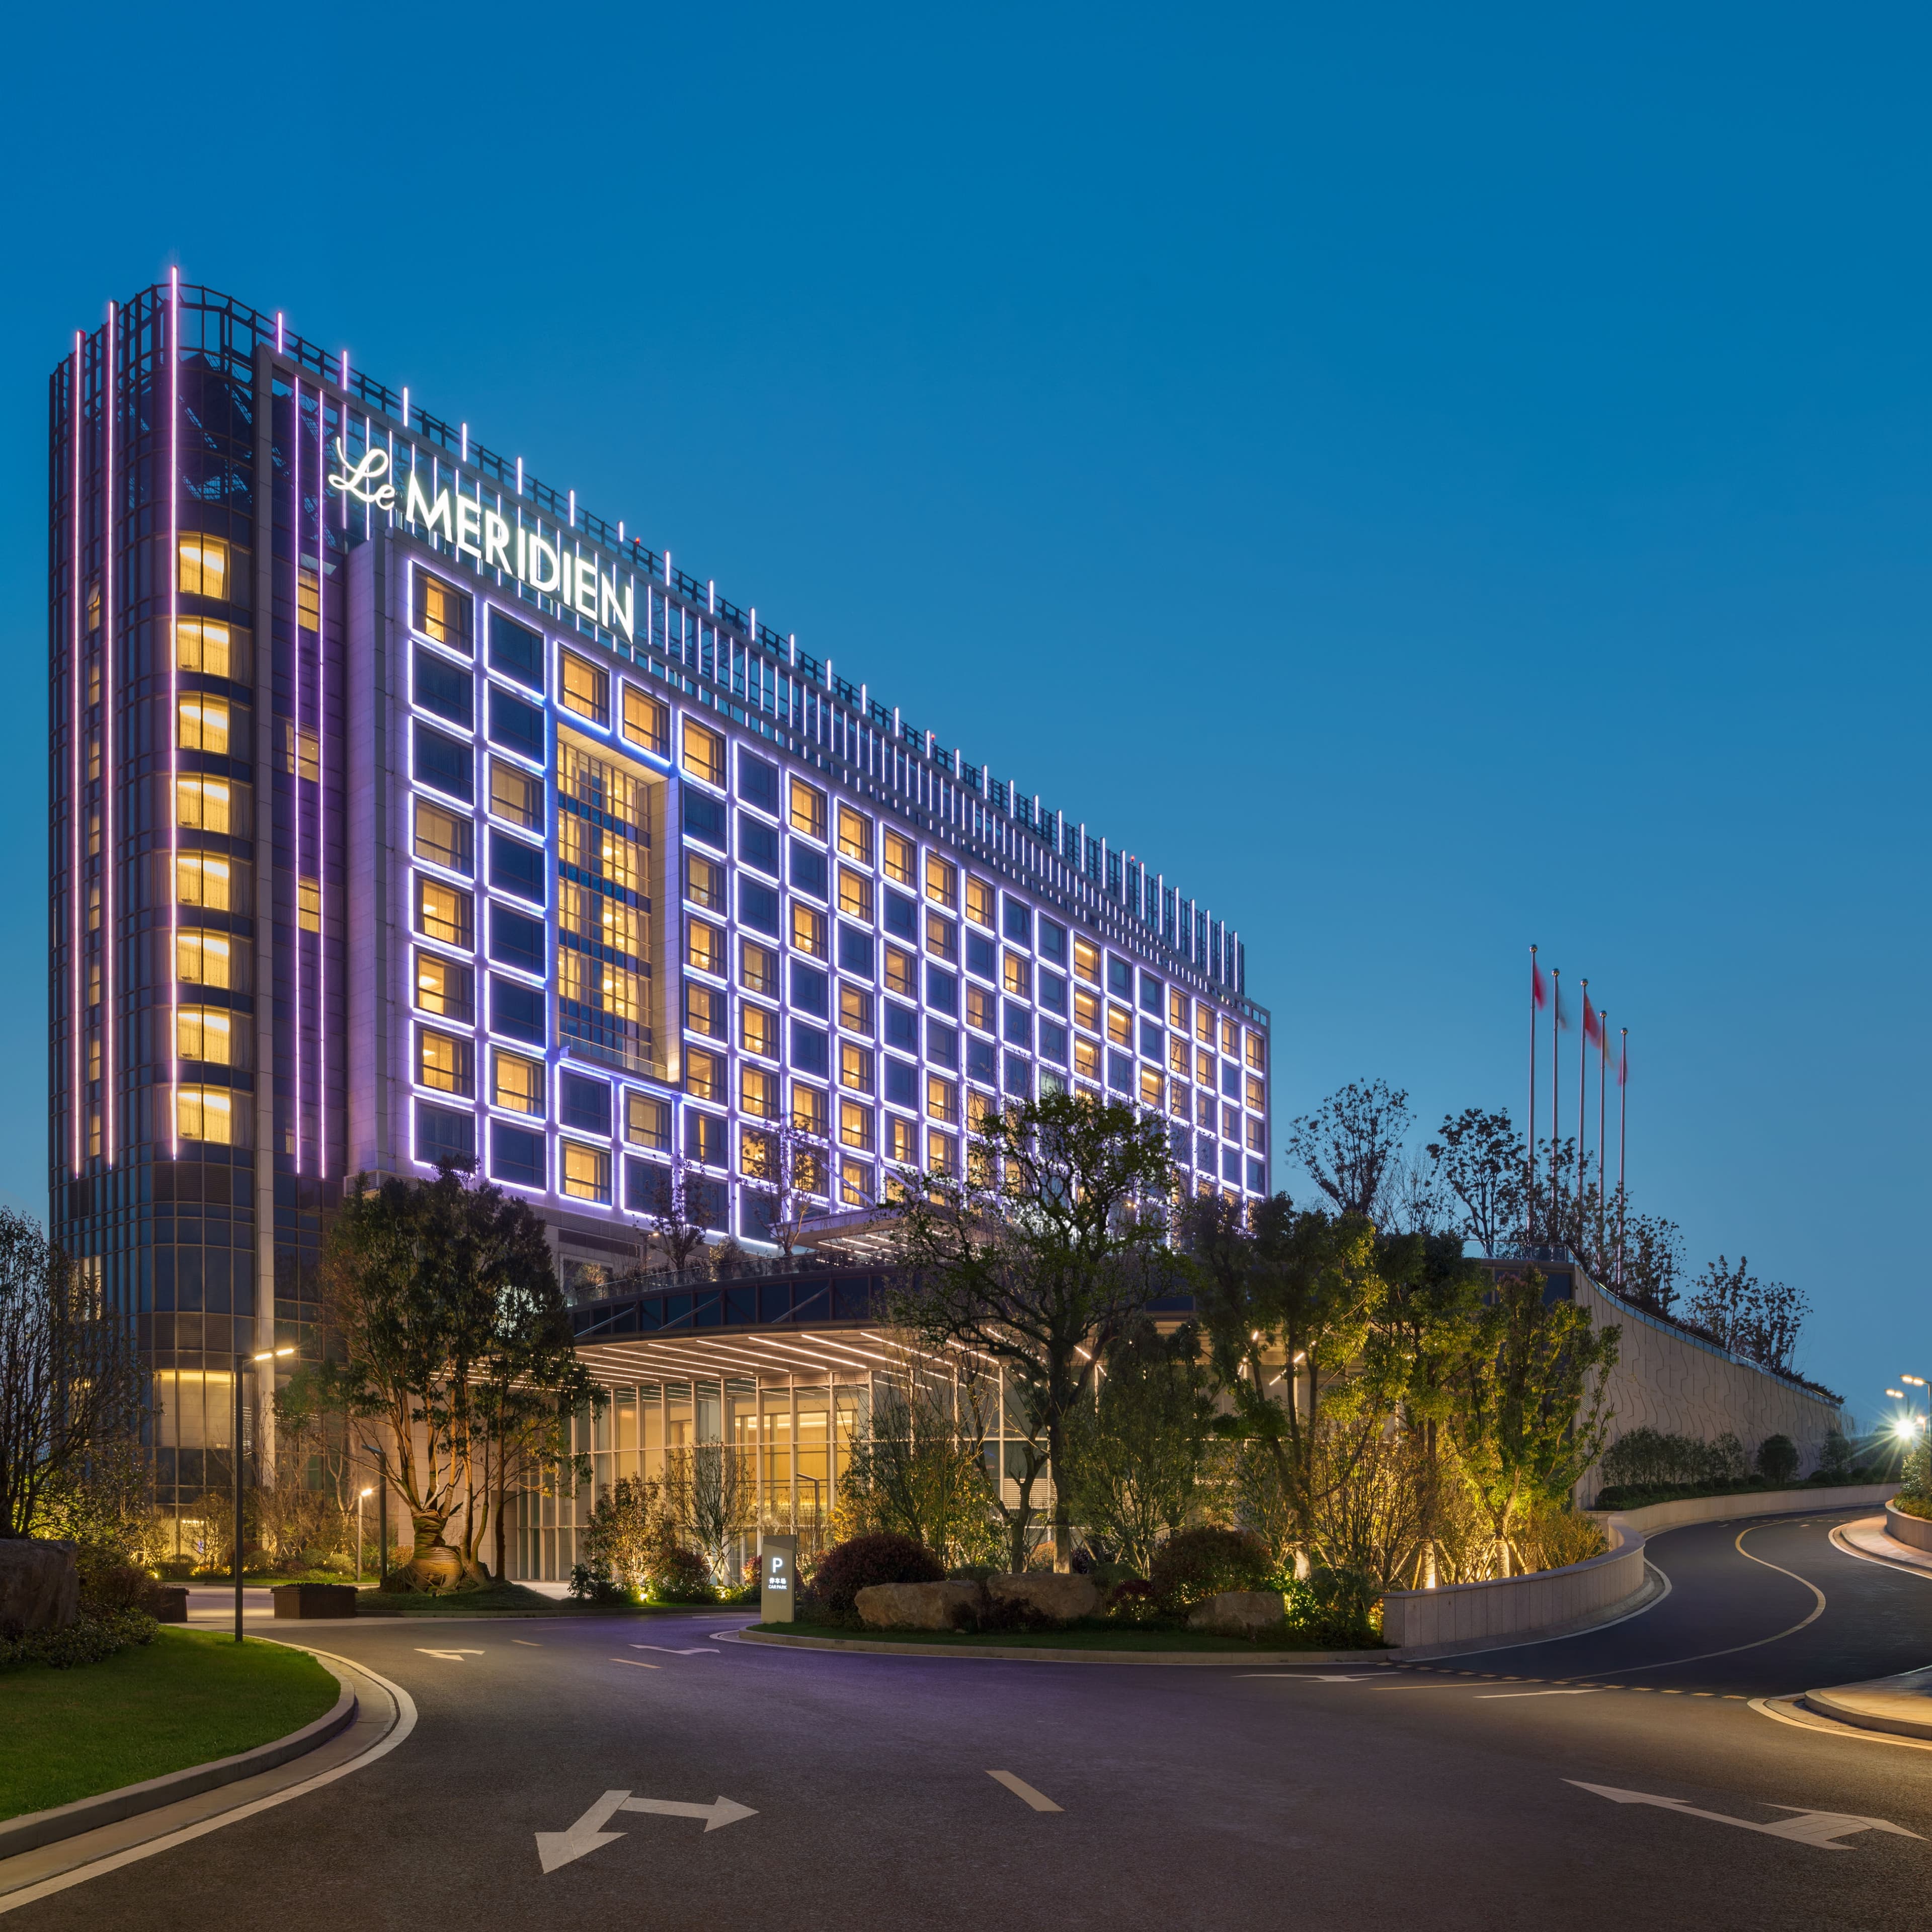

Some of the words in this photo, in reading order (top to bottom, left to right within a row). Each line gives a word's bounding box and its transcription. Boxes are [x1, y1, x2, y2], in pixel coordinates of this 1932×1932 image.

[328, 436, 395, 510] Le
[406, 470, 633, 643] MERIDIEN
[772, 1557, 783, 1573] P
